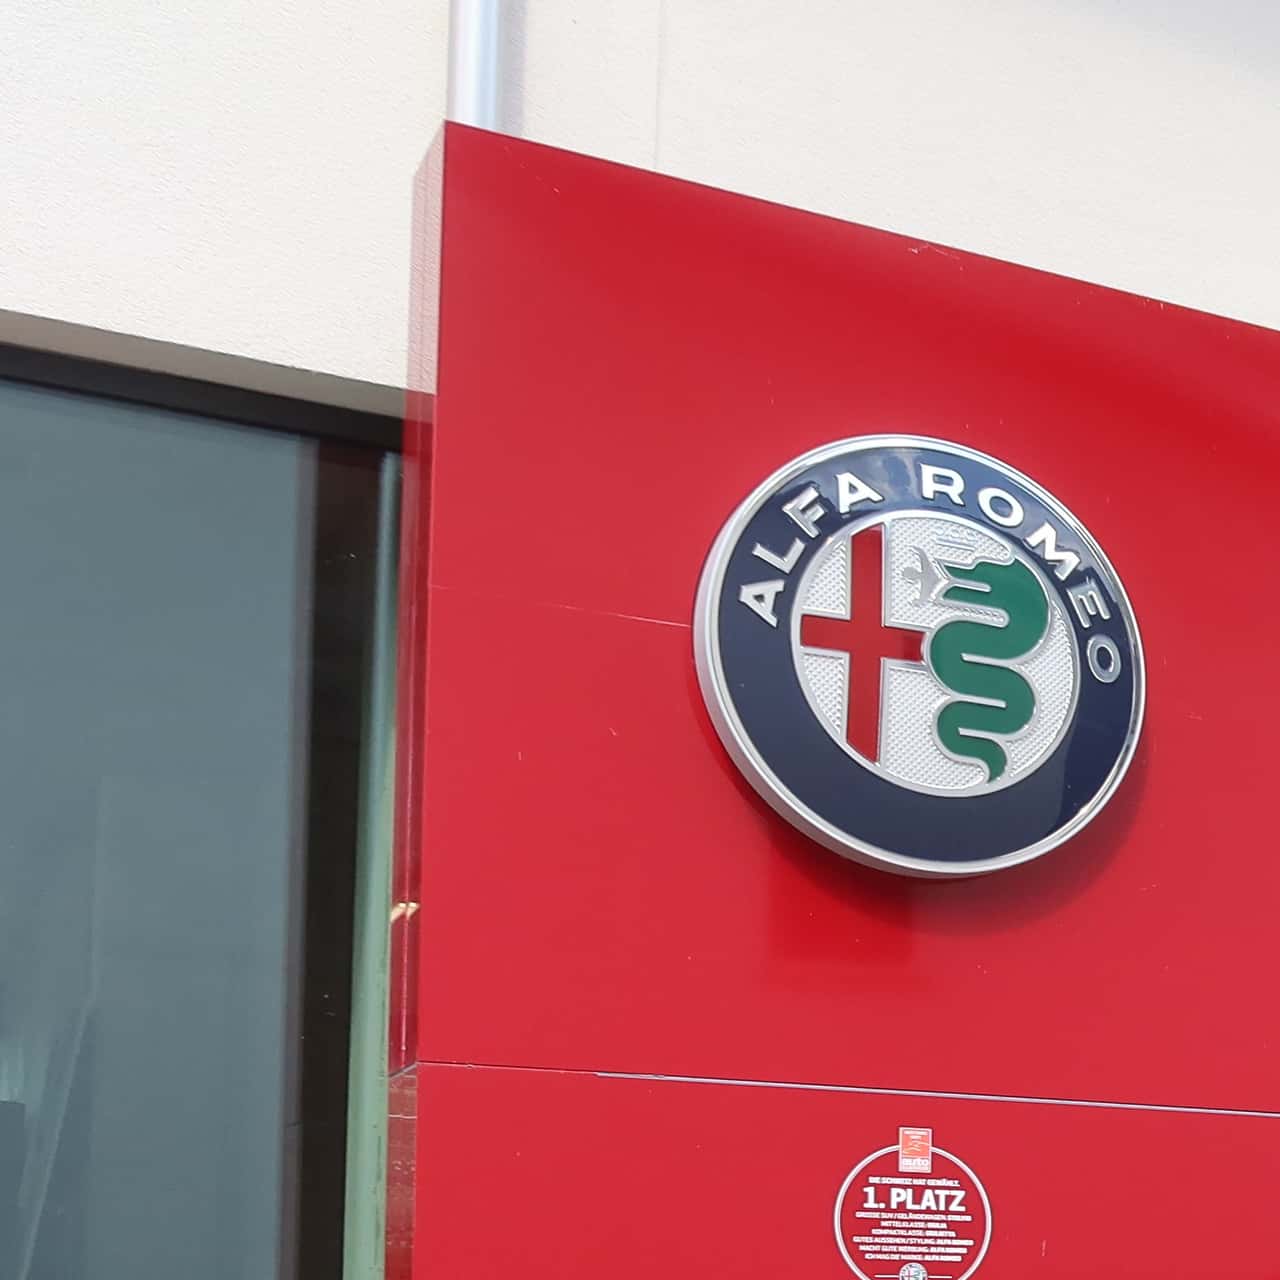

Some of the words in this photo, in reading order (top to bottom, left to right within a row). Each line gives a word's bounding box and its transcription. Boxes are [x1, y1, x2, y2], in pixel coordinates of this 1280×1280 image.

[739, 471, 884, 627] ALFA
[920, 462, 1122, 683] ROMEO
[863, 1187, 885, 1208] 1.
[890, 1187, 966, 1211] PLATZ
